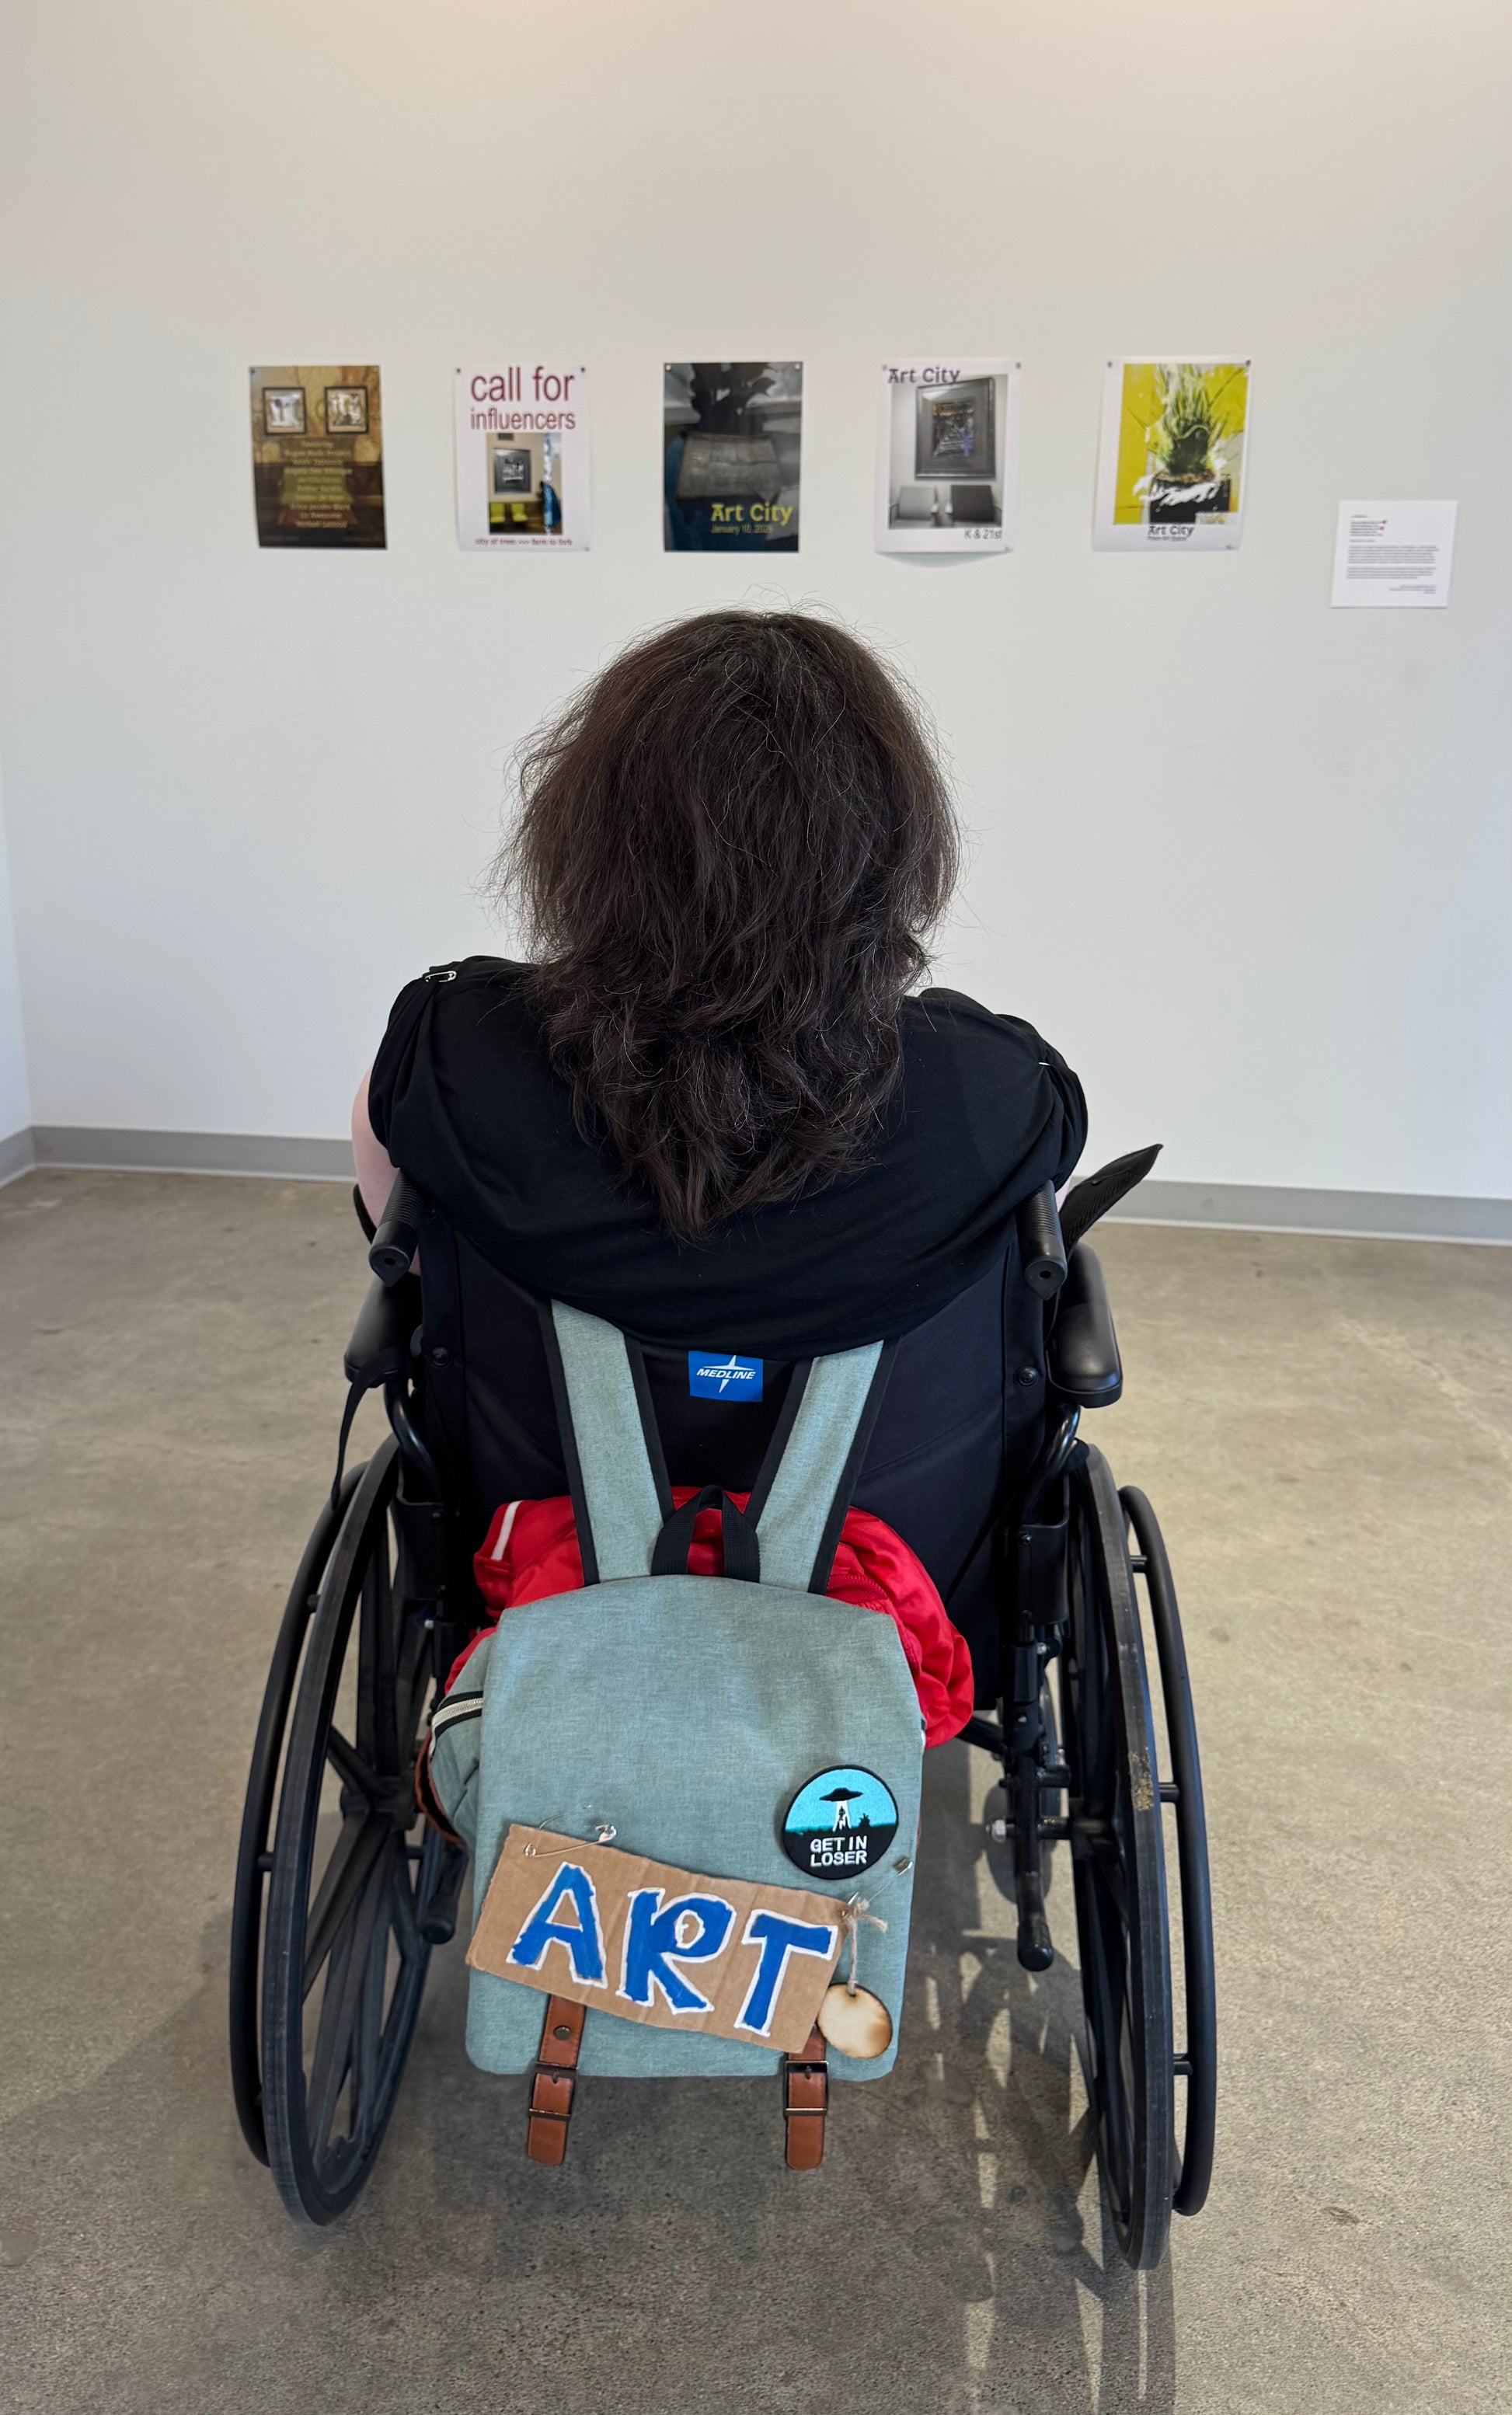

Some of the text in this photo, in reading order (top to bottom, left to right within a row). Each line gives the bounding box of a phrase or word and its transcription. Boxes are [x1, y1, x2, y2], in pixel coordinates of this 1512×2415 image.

[471, 366, 576, 402] call for
[887, 366, 960, 385] Art City
[470, 407, 577, 430] influencers
[711, 501, 793, 526] Art City
[712, 524, 740, 535] January
[1148, 524, 1195, 538] Art City
[696, 1368, 756, 1379] MEDLINE
[810, 1835, 868, 1854] GET IN
[810, 1850, 868, 1868] LOSER
[505, 1861, 839, 2037] ART
